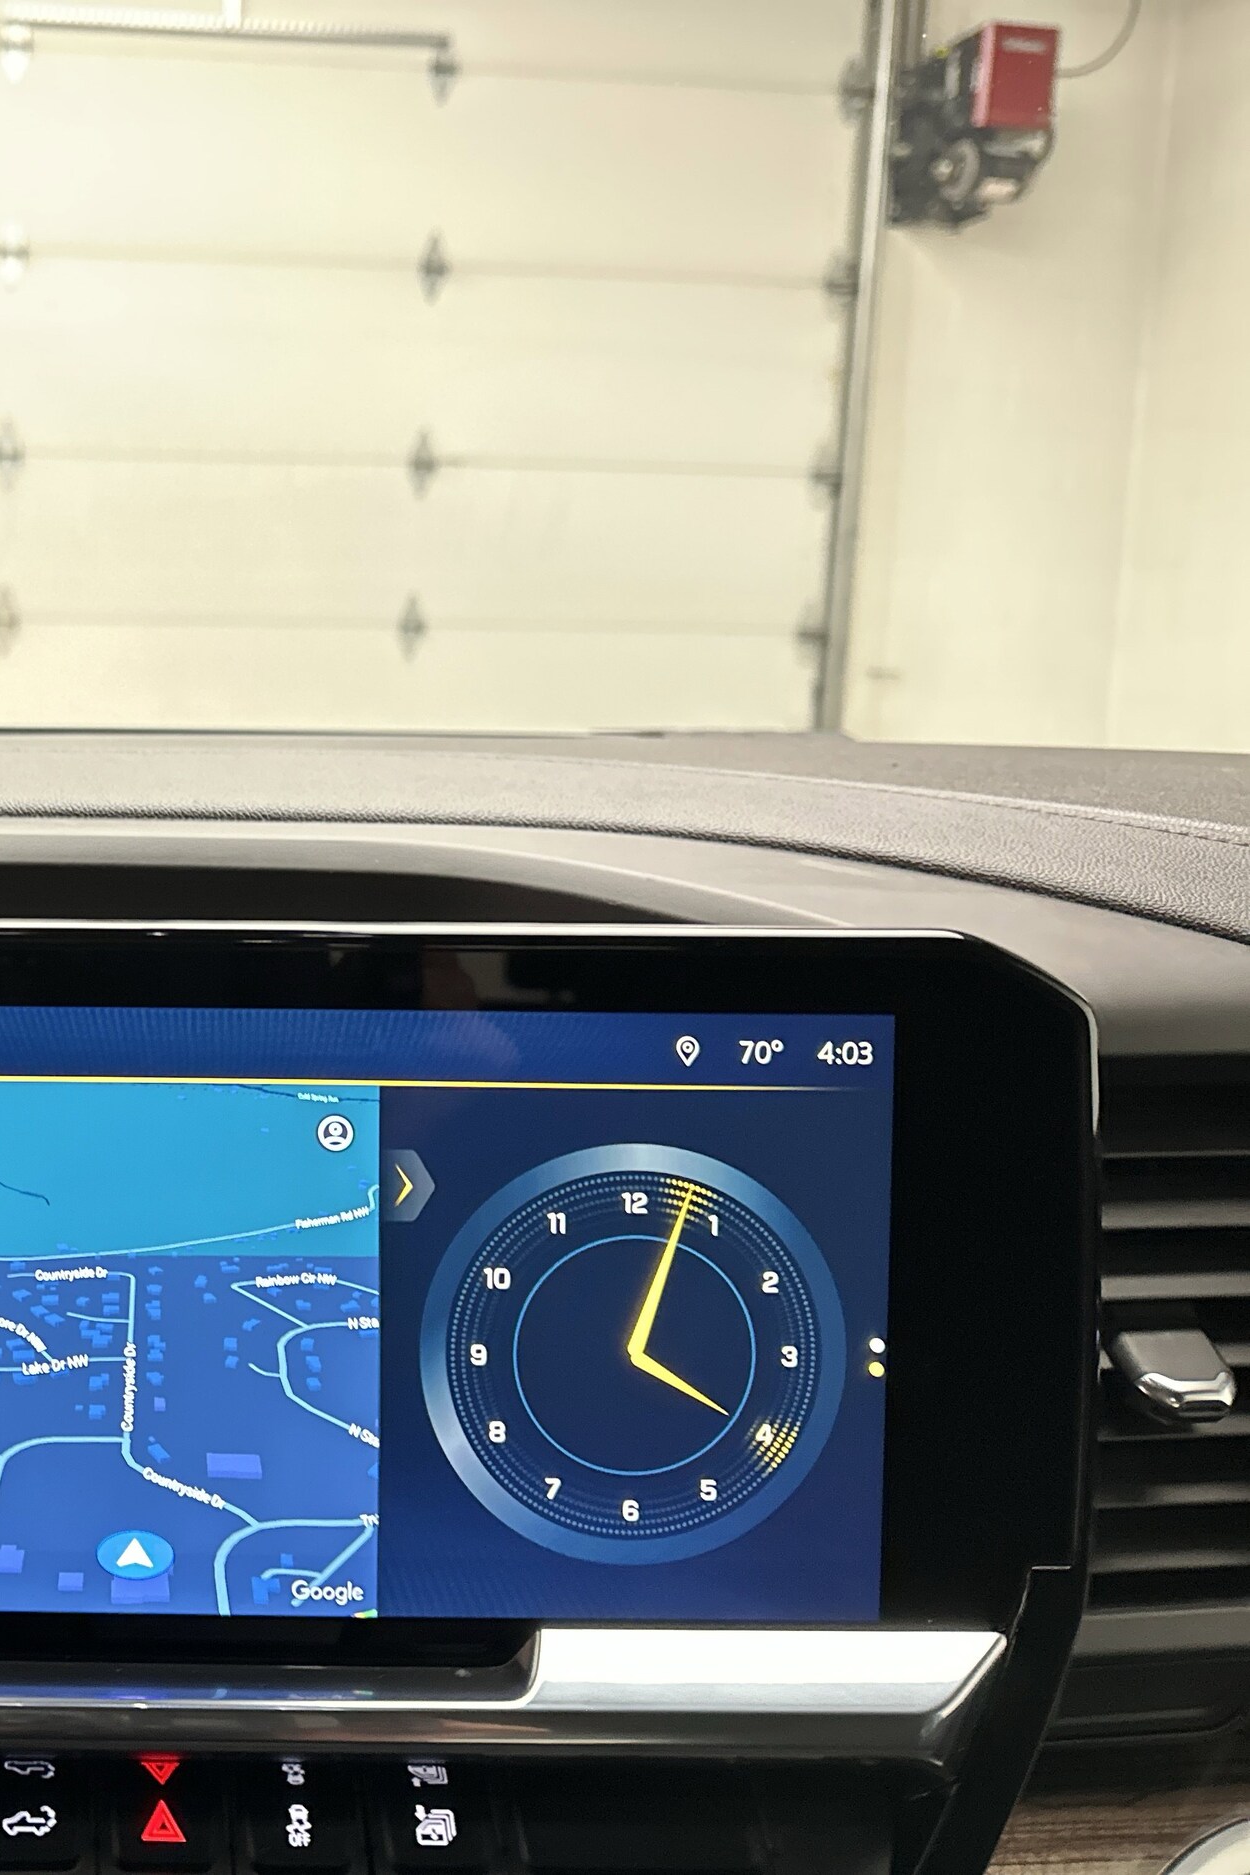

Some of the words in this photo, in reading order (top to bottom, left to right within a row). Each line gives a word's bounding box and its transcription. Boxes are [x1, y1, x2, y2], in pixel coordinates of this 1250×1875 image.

[738, 1039, 784, 1066] 70°
[817, 1041, 874, 1066] 4:03
[340, 1209, 354, 1223] Rd
[353, 1205, 370, 1219] NW
[622, 1192, 648, 1214] 12
[547, 1212, 567, 1234] 11
[708, 1214, 719, 1236] 1
[34, 1266, 95, 1282] Countryside
[95, 1266, 109, 1279] Dr
[255, 1274, 300, 1288] Rainbow
[300, 1272, 317, 1284] Cir
[317, 1272, 338, 1285] NW
[483, 1268, 511, 1290] 10
[762, 1271, 779, 1293] 2
[15, 1323, 30, 1338] Dr
[347, 1317, 359, 1330] N
[123, 1342, 137, 1357] Dr
[469, 1344, 487, 1367] 9
[781, 1346, 798, 1368] 3
[21, 1360, 50, 1376] Lake
[50, 1358, 67, 1373] Dr
[66, 1353, 89, 1370] NW
[120, 1358, 138, 1432] Countryside
[348, 1422, 362, 1439] N
[488, 1421, 507, 1443] 8
[755, 1423, 773, 1444] 4
[142, 1466, 212, 1504] Countryside
[210, 1494, 226, 1510] Dr
[544, 1477, 562, 1499] 7
[699, 1479, 717, 1501] 5
[622, 1500, 640, 1522] 6
[291, 1580, 364, 1606] Google
